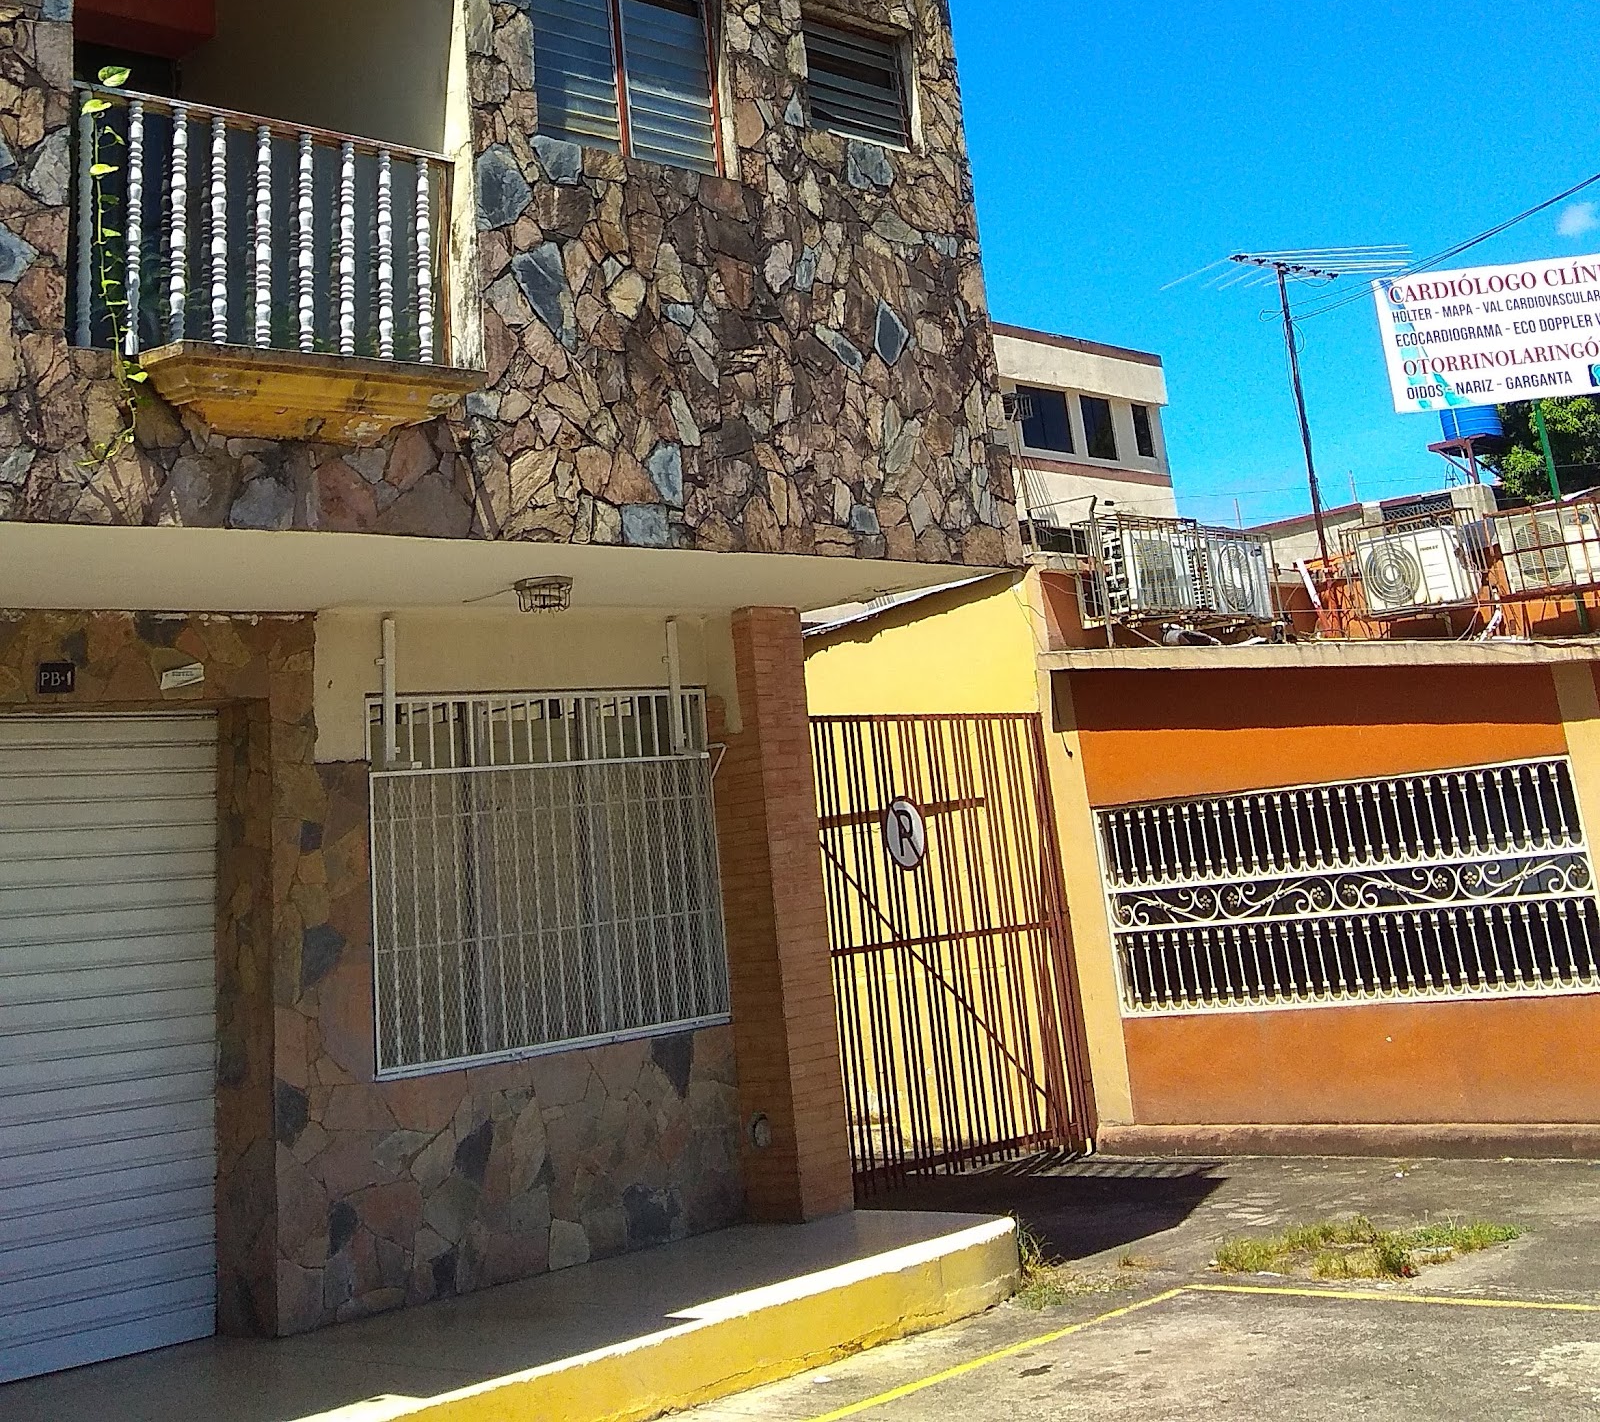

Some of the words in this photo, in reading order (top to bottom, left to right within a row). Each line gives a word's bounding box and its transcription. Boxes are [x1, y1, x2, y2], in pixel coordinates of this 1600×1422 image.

[1389, 272, 1537, 304] CARDIÓLOGO
[1392, 308, 1433, 323] HOLTER
[1441, 303, 1473, 318] MAPA
[1482, 300, 1504, 314] VAL
[1506, 289, 1600, 311] CARDIOVASCULAR
[1395, 324, 1503, 348] ECOCARDIOGRAMA
[1513, 319, 1537, 335] ECO
[1539, 314, 1593, 332] DOPPLER
[1403, 336, 1600, 376] OTORRINOLARINGÓ
[1407, 384, 1444, 400] OIDOS
[1455, 379, 1494, 395] NARIZ
[1505, 371, 1573, 390] GARGANTA
